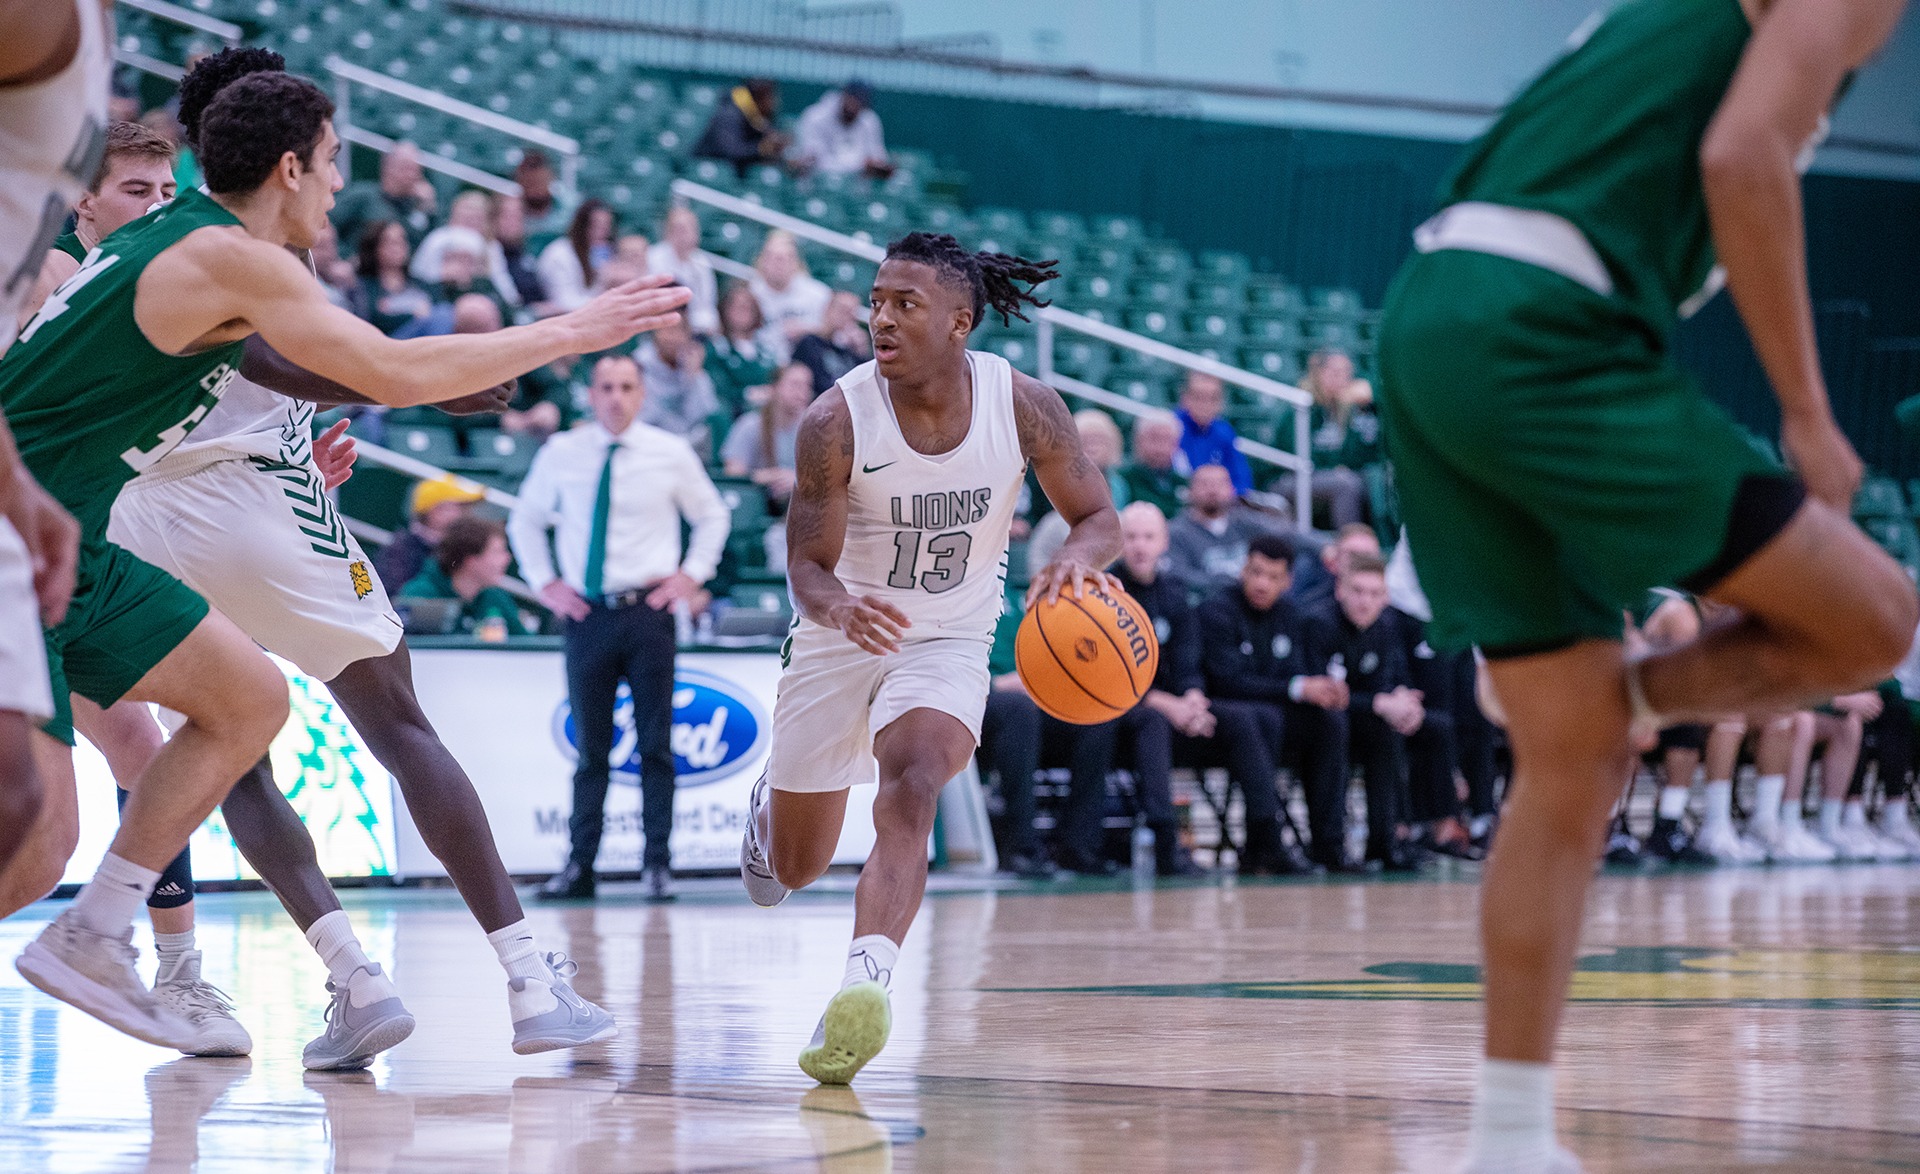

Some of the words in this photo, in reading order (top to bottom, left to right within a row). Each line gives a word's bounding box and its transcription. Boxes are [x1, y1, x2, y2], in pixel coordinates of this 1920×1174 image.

[18, 247, 121, 344] 4
[891, 487, 992, 530] LIONS
[887, 530, 973, 594] 13
